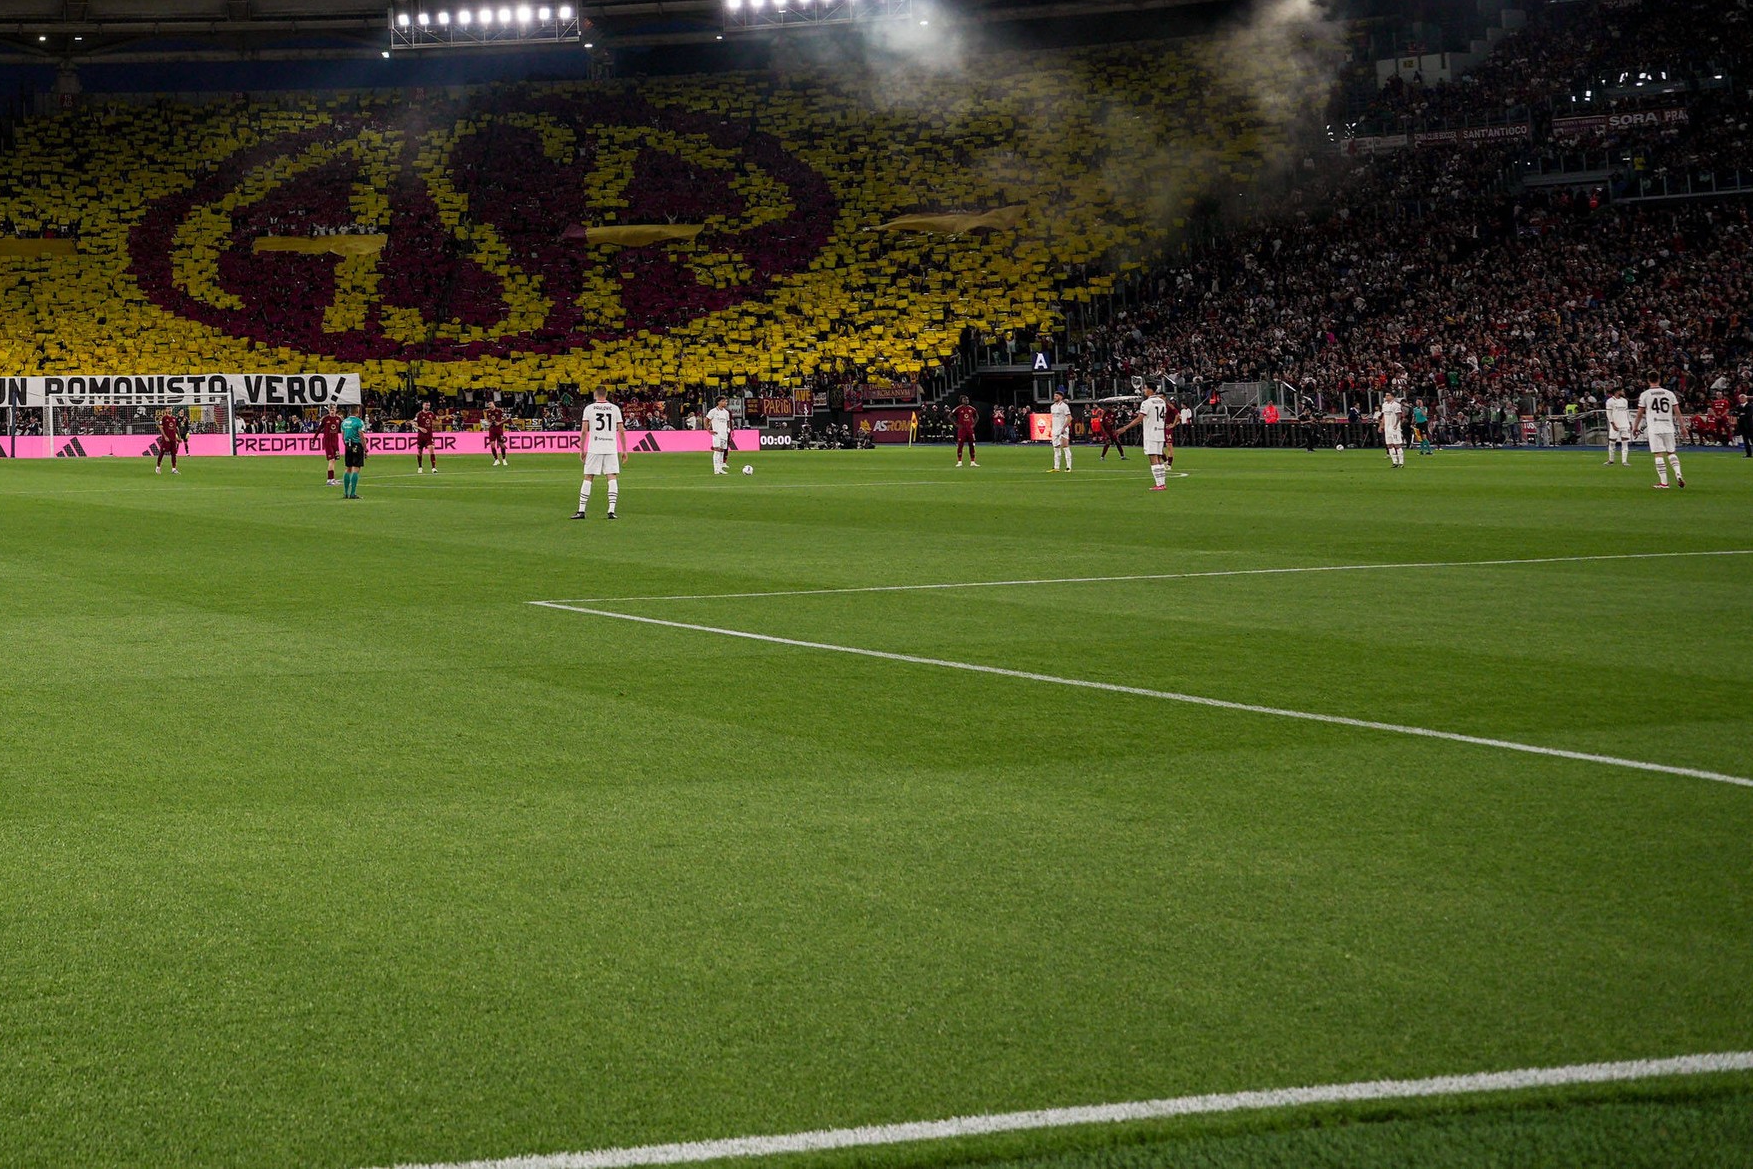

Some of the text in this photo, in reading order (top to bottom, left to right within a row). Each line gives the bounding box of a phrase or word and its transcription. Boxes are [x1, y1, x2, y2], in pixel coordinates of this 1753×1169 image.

[1608, 112, 1659, 126] SORA
[1034, 352, 1048, 370] A
[244, 375, 346, 405] VERO!
[1155, 406, 1164, 422] 14
[1652, 397, 1670, 414] 46
[596, 413, 611, 431] 31
[760, 435, 791, 446] 00:00
